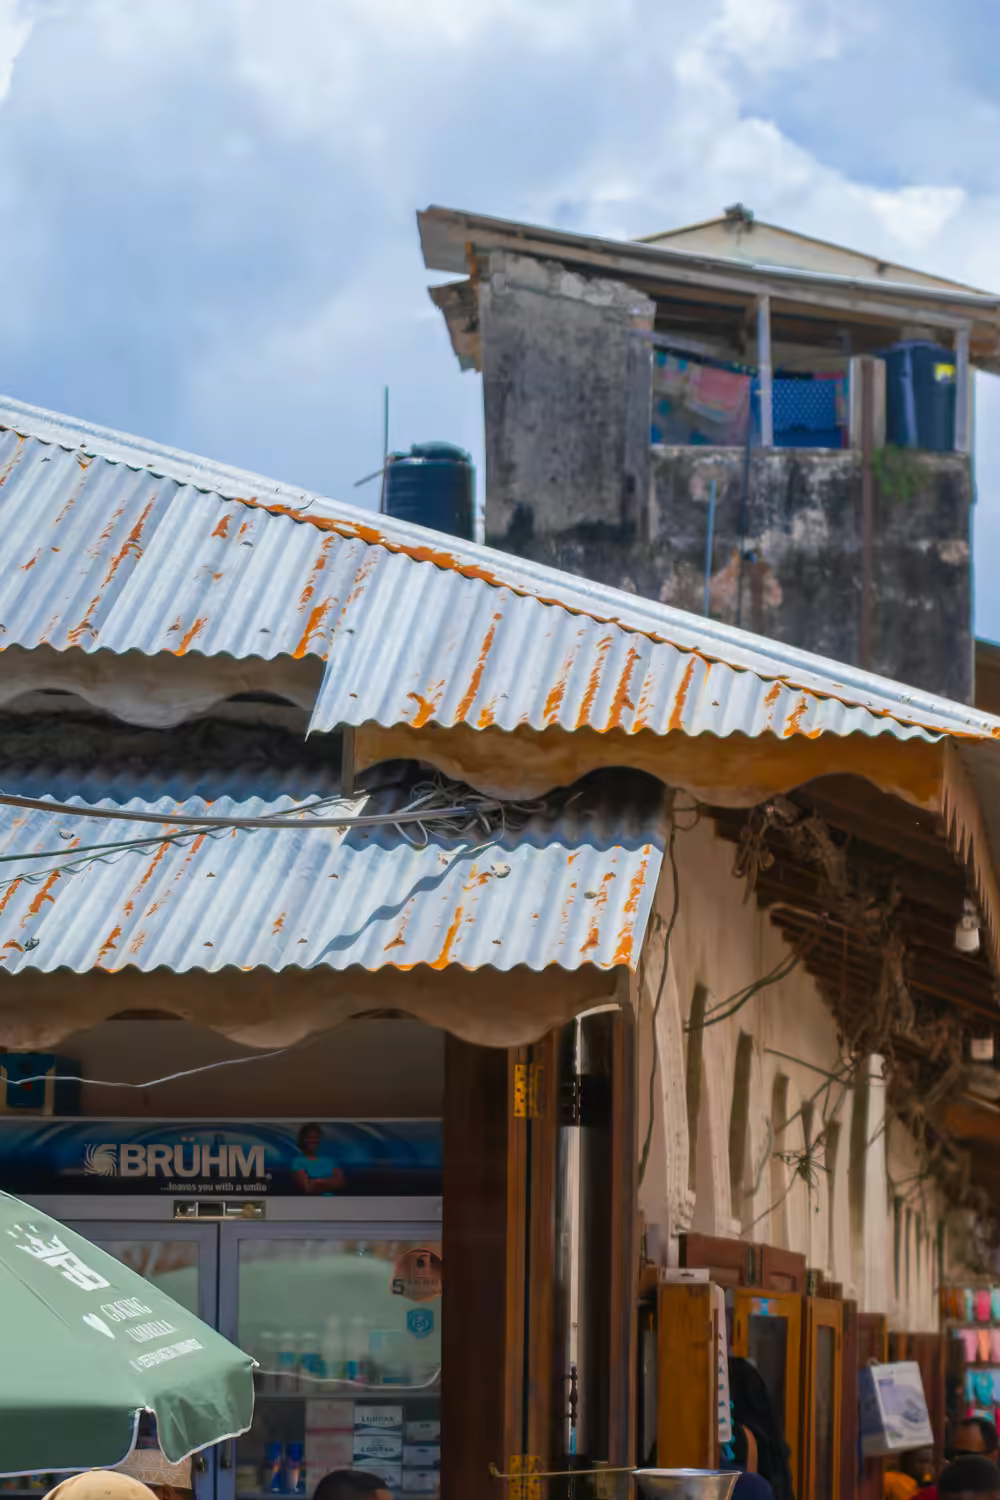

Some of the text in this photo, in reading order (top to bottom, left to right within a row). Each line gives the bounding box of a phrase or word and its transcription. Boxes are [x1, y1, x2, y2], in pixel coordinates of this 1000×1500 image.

[120, 1137, 265, 1177] BRÜHM
[198, 1183, 214, 1193] you
[215, 1181, 234, 1192] with
[243, 1181, 267, 1192] smile
